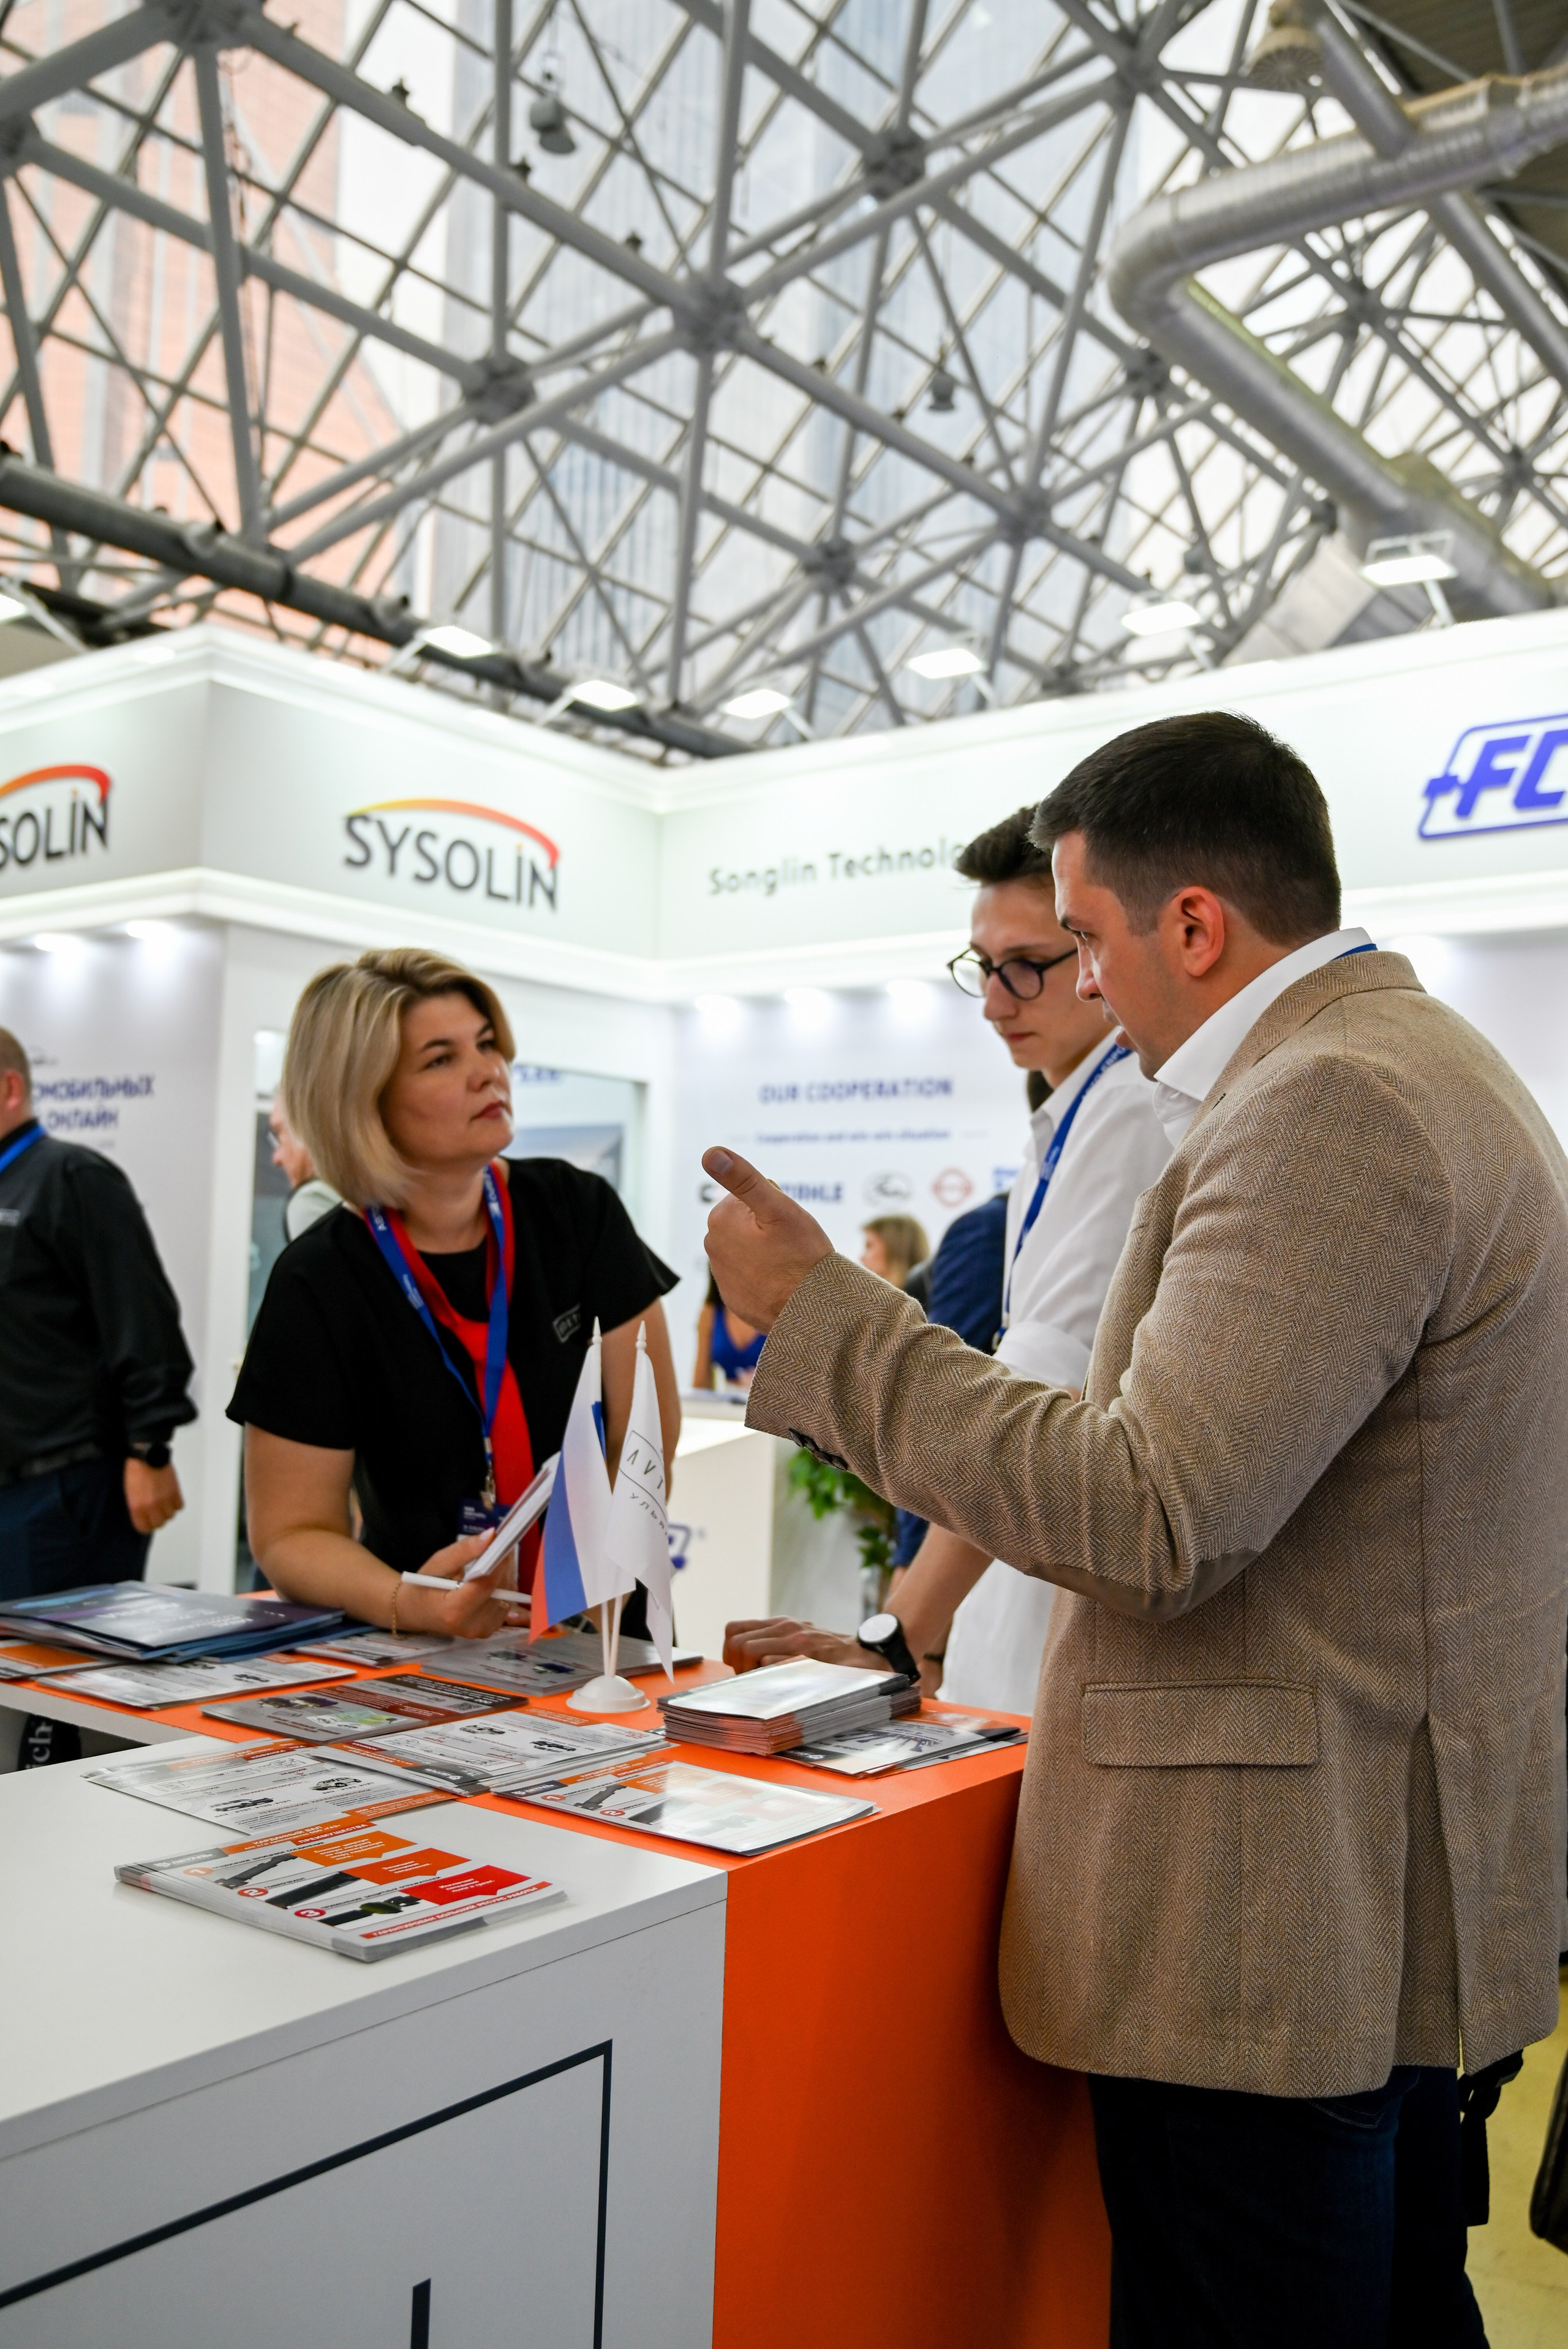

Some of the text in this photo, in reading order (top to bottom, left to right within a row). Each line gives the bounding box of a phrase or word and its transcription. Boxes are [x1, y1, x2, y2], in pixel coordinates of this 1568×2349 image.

[708, 837, 966, 895] Songlin Technolo
[760, 1078, 952, 1104] OUR COOPERATION
[630, 1492, 666, 1534] УЛЬЯ
[250, 1749, 287, 1759] НОВИНКА
[252, 1825, 323, 1845] КАРДАННЫЙ ВАЛ
[298, 1823, 369, 1844] ПРЕИМУЩЕСТВА
[507, 1887, 538, 1899] РАБОТЫ
